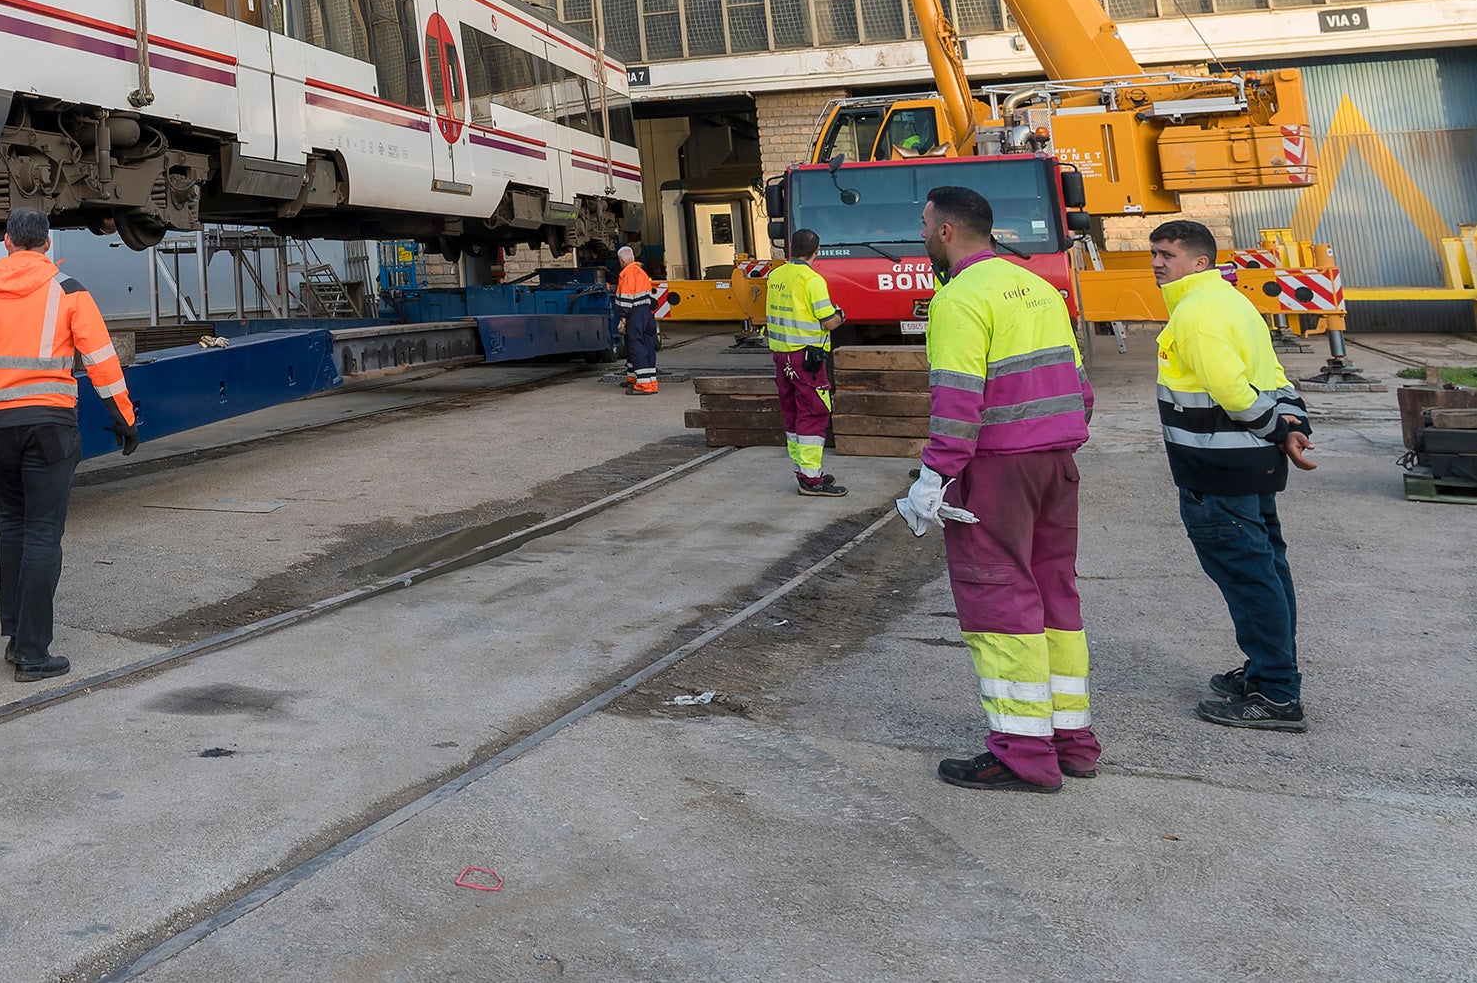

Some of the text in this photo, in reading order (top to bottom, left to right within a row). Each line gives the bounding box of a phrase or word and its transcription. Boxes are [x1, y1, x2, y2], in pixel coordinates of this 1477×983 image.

[1325, 12, 1361, 28] VIA 9
[627, 71, 645, 83] IA 7
[1060, 151, 1102, 161] ONET
[877, 273, 934, 291] BON
